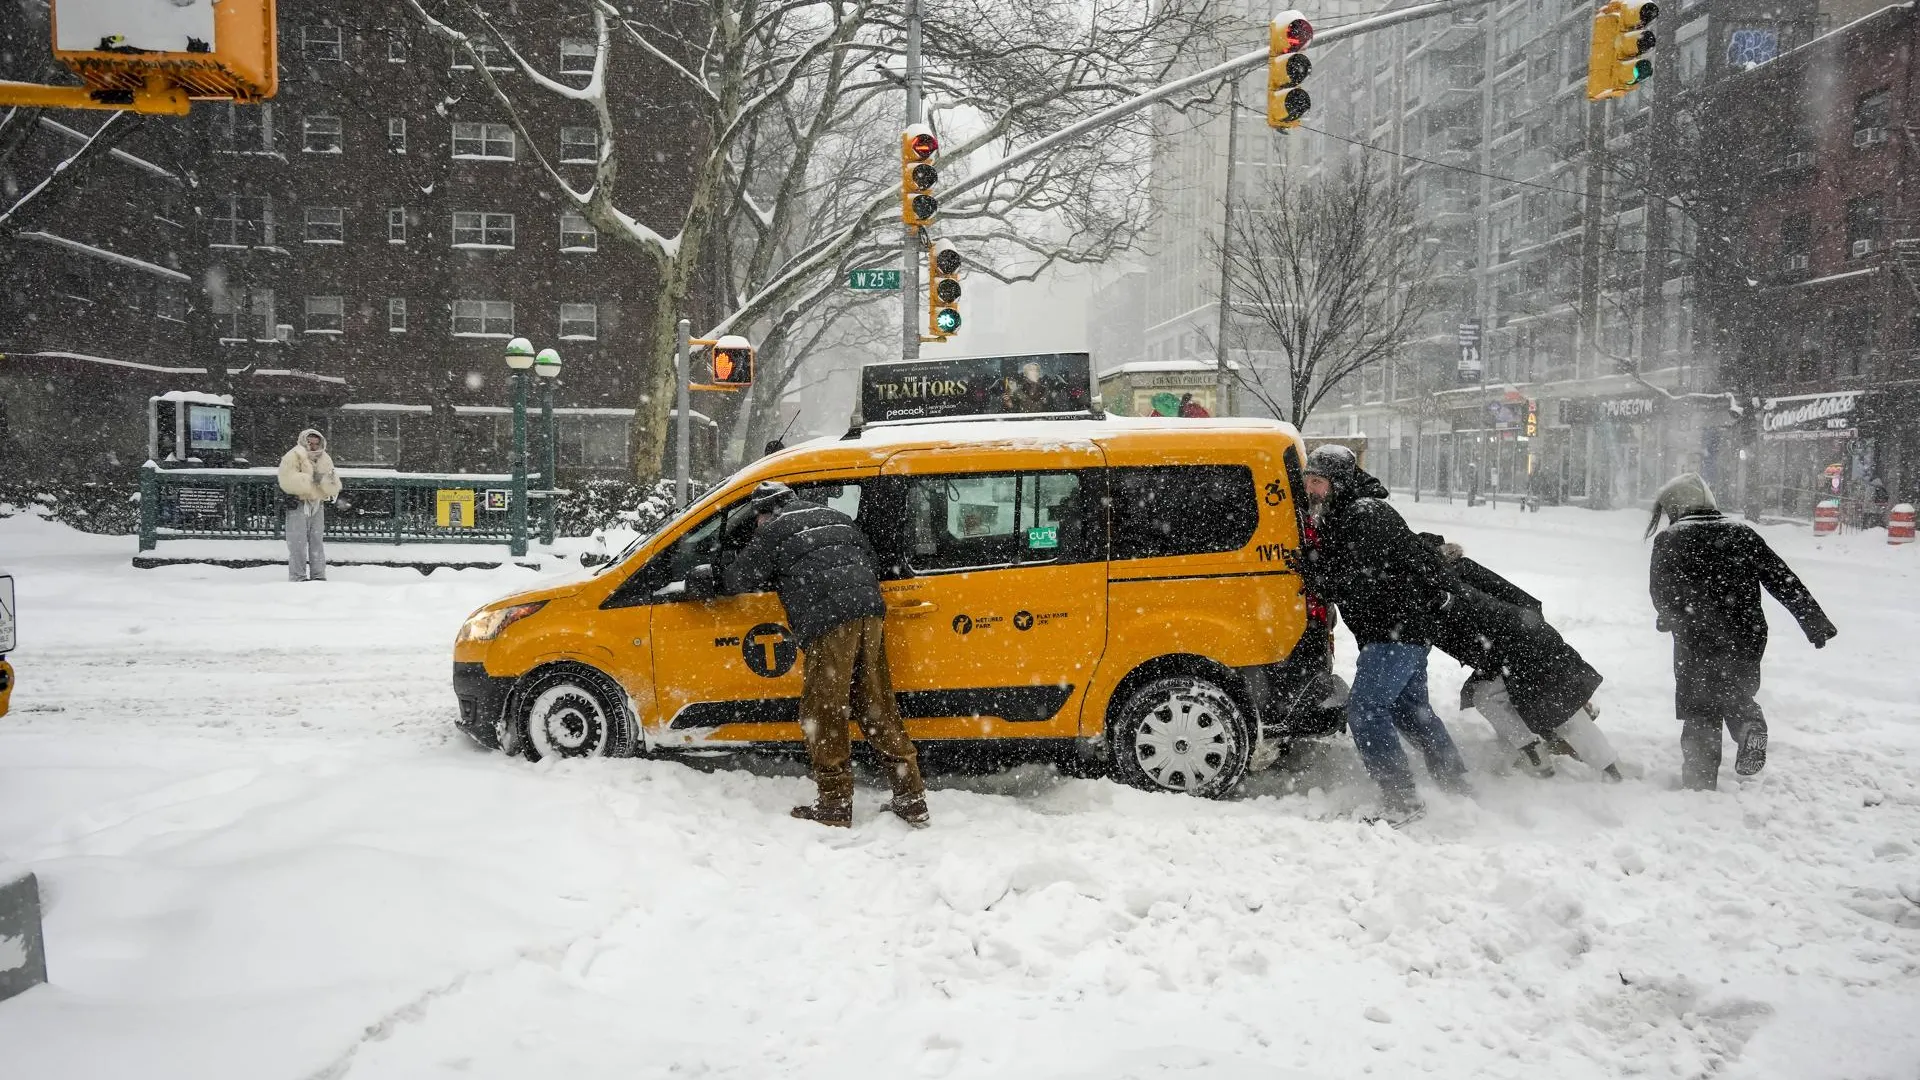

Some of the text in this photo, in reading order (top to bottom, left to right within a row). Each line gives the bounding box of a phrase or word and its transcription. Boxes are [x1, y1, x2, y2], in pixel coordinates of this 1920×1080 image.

[857, 272, 866, 287] W
[870, 272, 884, 287] 25
[876, 376, 968, 400] TRAITORS
[886, 406, 925, 420] peacock
[1527, 398, 1537, 437] BAR
[1763, 394, 1855, 431] Convenience
[1826, 418, 1847, 429] NYC
[1029, 530, 1057, 540] curb
[714, 633, 784, 672] NYC T
